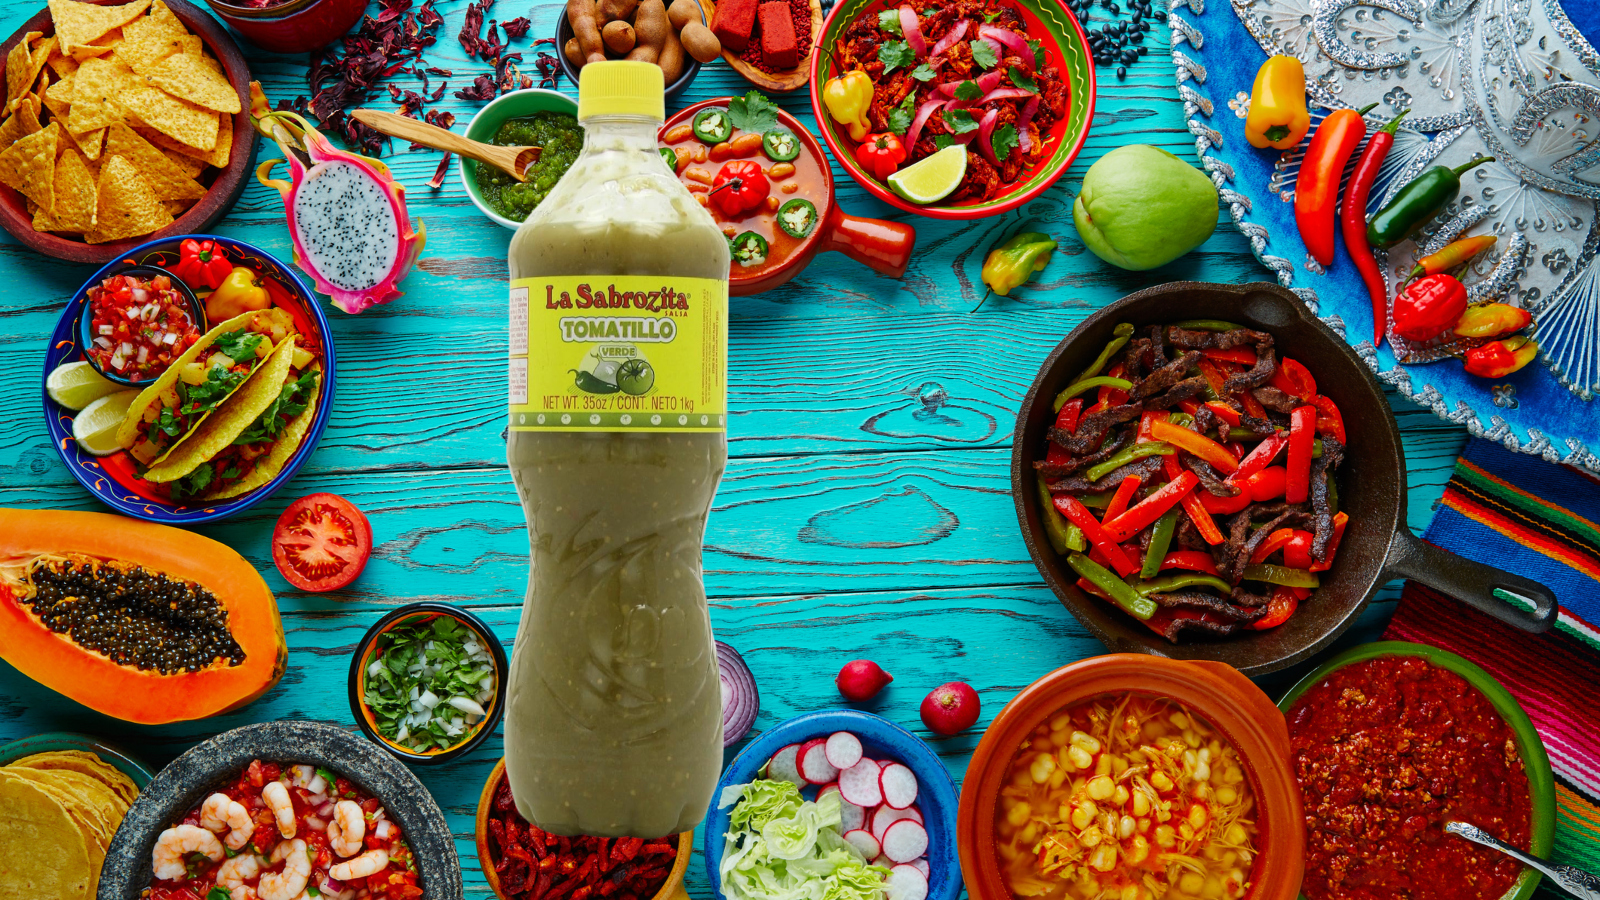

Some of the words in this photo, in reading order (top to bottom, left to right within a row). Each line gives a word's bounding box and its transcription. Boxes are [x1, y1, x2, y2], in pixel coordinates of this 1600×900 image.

[546, 285, 573, 310] La
[576, 284, 689, 313] Sabrozita
[563, 320, 674, 339] TOMATILLO
[601, 347, 636, 357] VERDE
[543, 395, 560, 410] NET
[562, 395, 579, 410] WT.
[583, 395, 608, 410] 35oz
[616, 396, 648, 410] CONT.
[651, 396, 677, 410] NETO
[680, 395, 694, 413] 1kg
